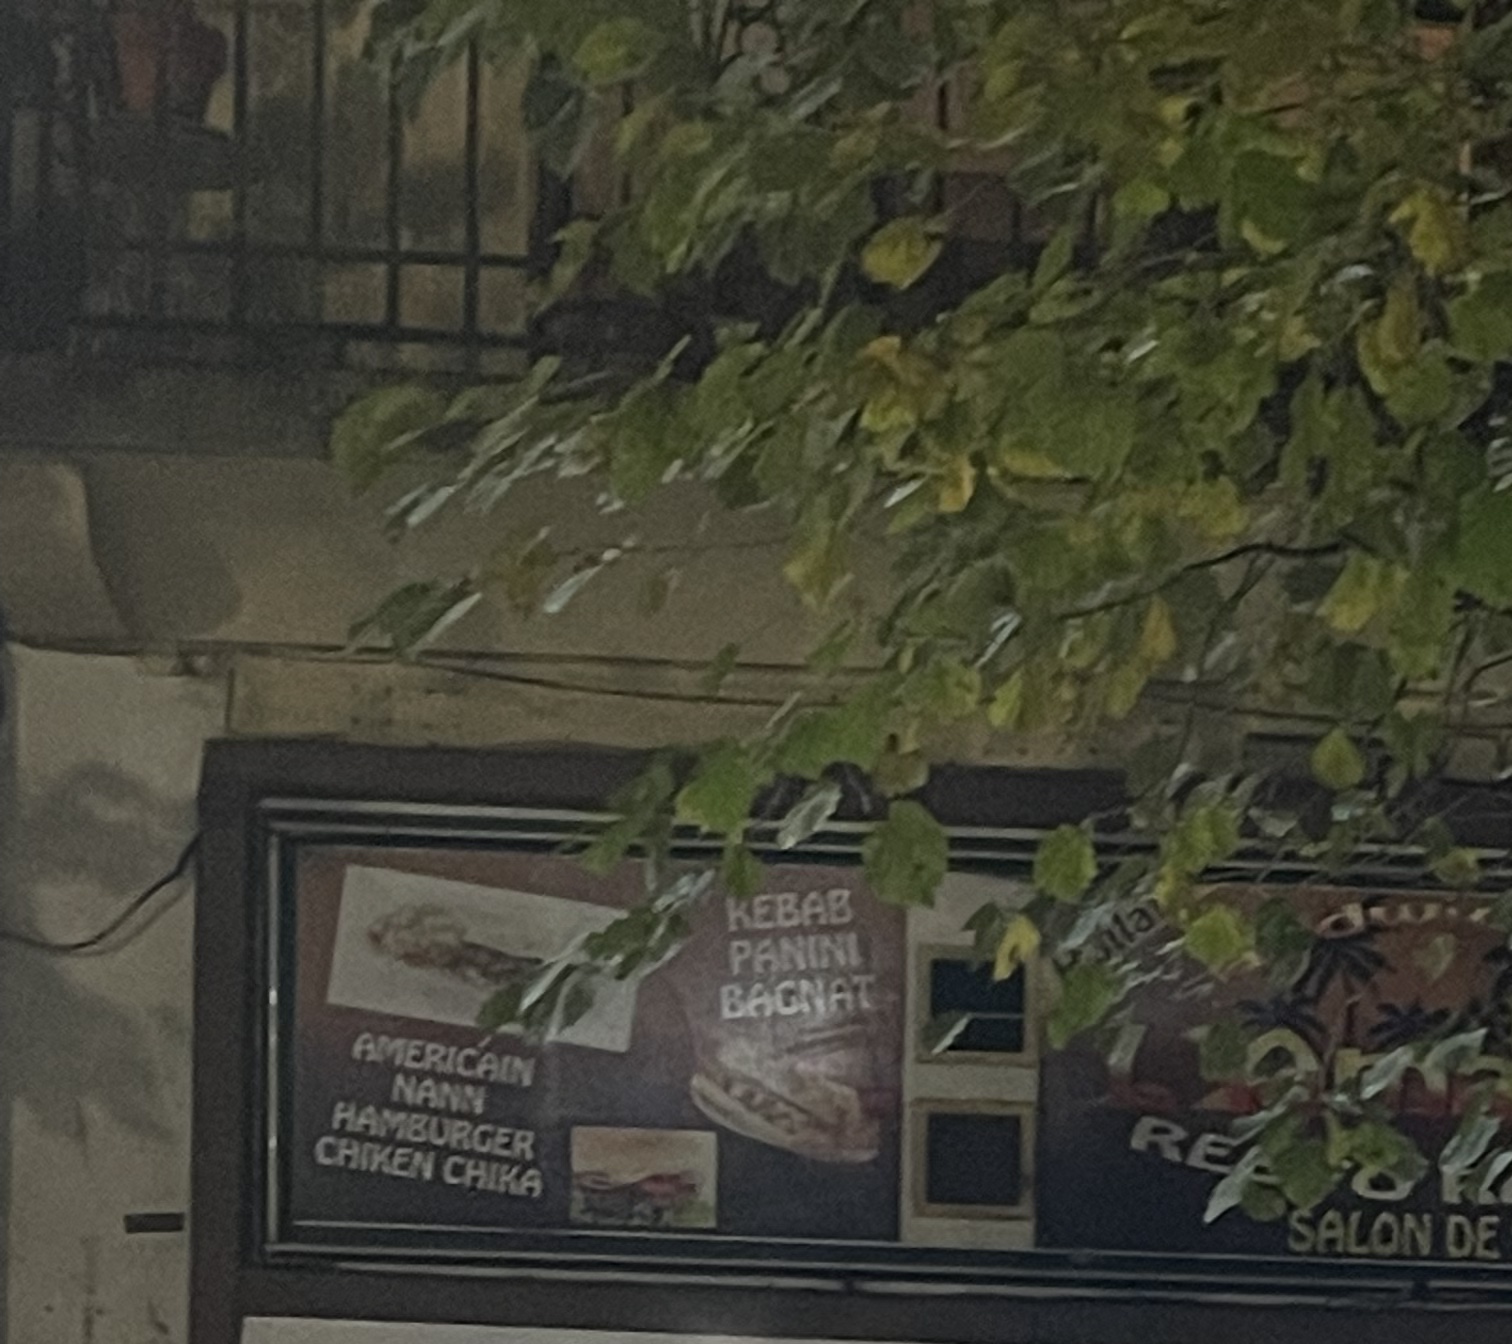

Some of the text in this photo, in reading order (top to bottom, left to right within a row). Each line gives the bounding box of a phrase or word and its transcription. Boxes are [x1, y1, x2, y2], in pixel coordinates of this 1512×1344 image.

[726, 888, 852, 932] KEBAB
[729, 932, 861, 976] PANINI
[718, 972, 876, 1020] BAGNAT
[350, 1032, 535, 1088] AMERICAIN
[332, 1102, 536, 1160] HAMBURGER
[442, 1151, 543, 1199] CHIKA
[1130, 1115, 1416, 1201] REO
[1287, 1209, 1433, 1256] SALON
[1446, 1214, 1500, 1259] DE
